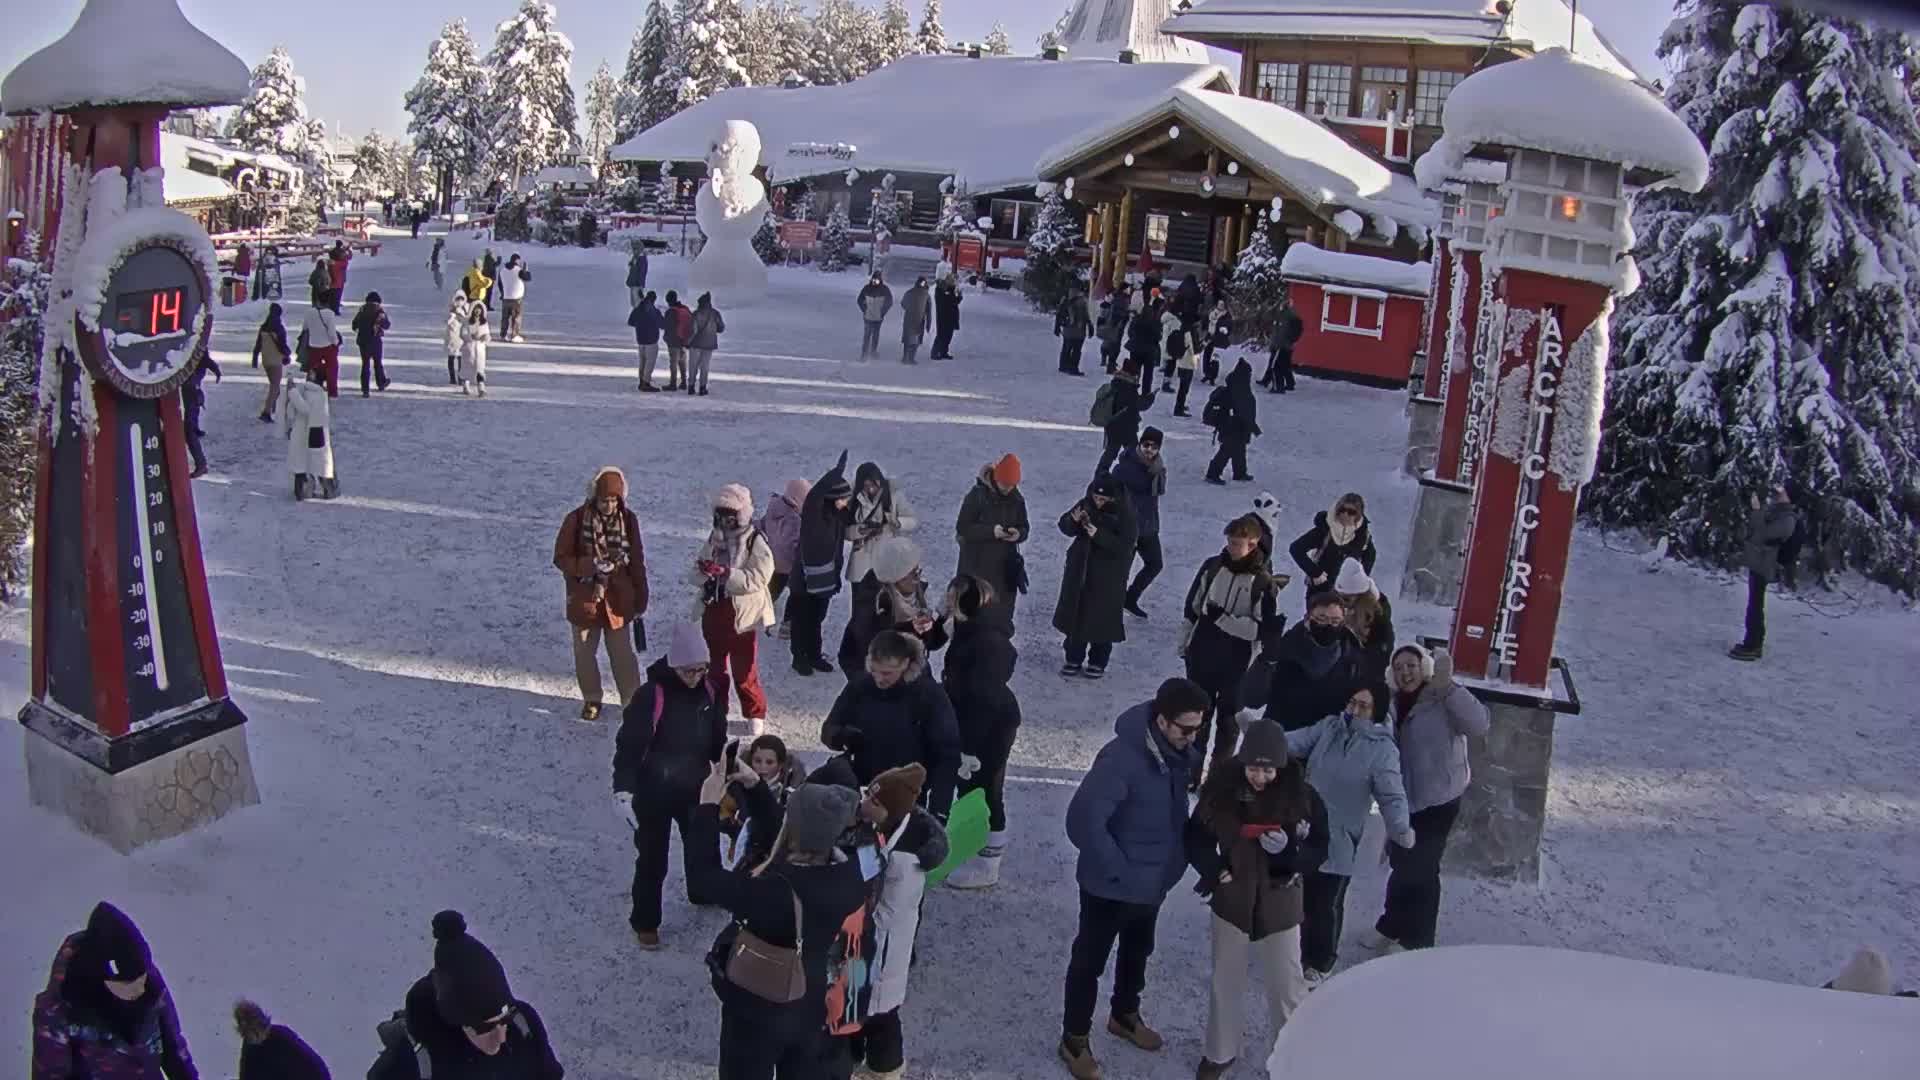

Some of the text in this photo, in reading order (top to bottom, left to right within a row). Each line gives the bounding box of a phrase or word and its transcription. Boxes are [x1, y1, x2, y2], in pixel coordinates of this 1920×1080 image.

[1462, 381, 1484, 477] CIRCLE
[144, 436, 159, 450] 40
[147, 464, 160, 478] 30
[1494, 316, 1562, 665] ARCTIC CIRCLE
[150, 492, 163, 506] 20
[152, 521, 165, 535] 10
[133, 555, 141, 568] 0
[155, 549, 163, 562] 0
[128, 582, 143, 596] -10
[130, 608, 147, 623] -20
[133, 635, 150, 649] -30
[135, 662, 154, 677] -40
